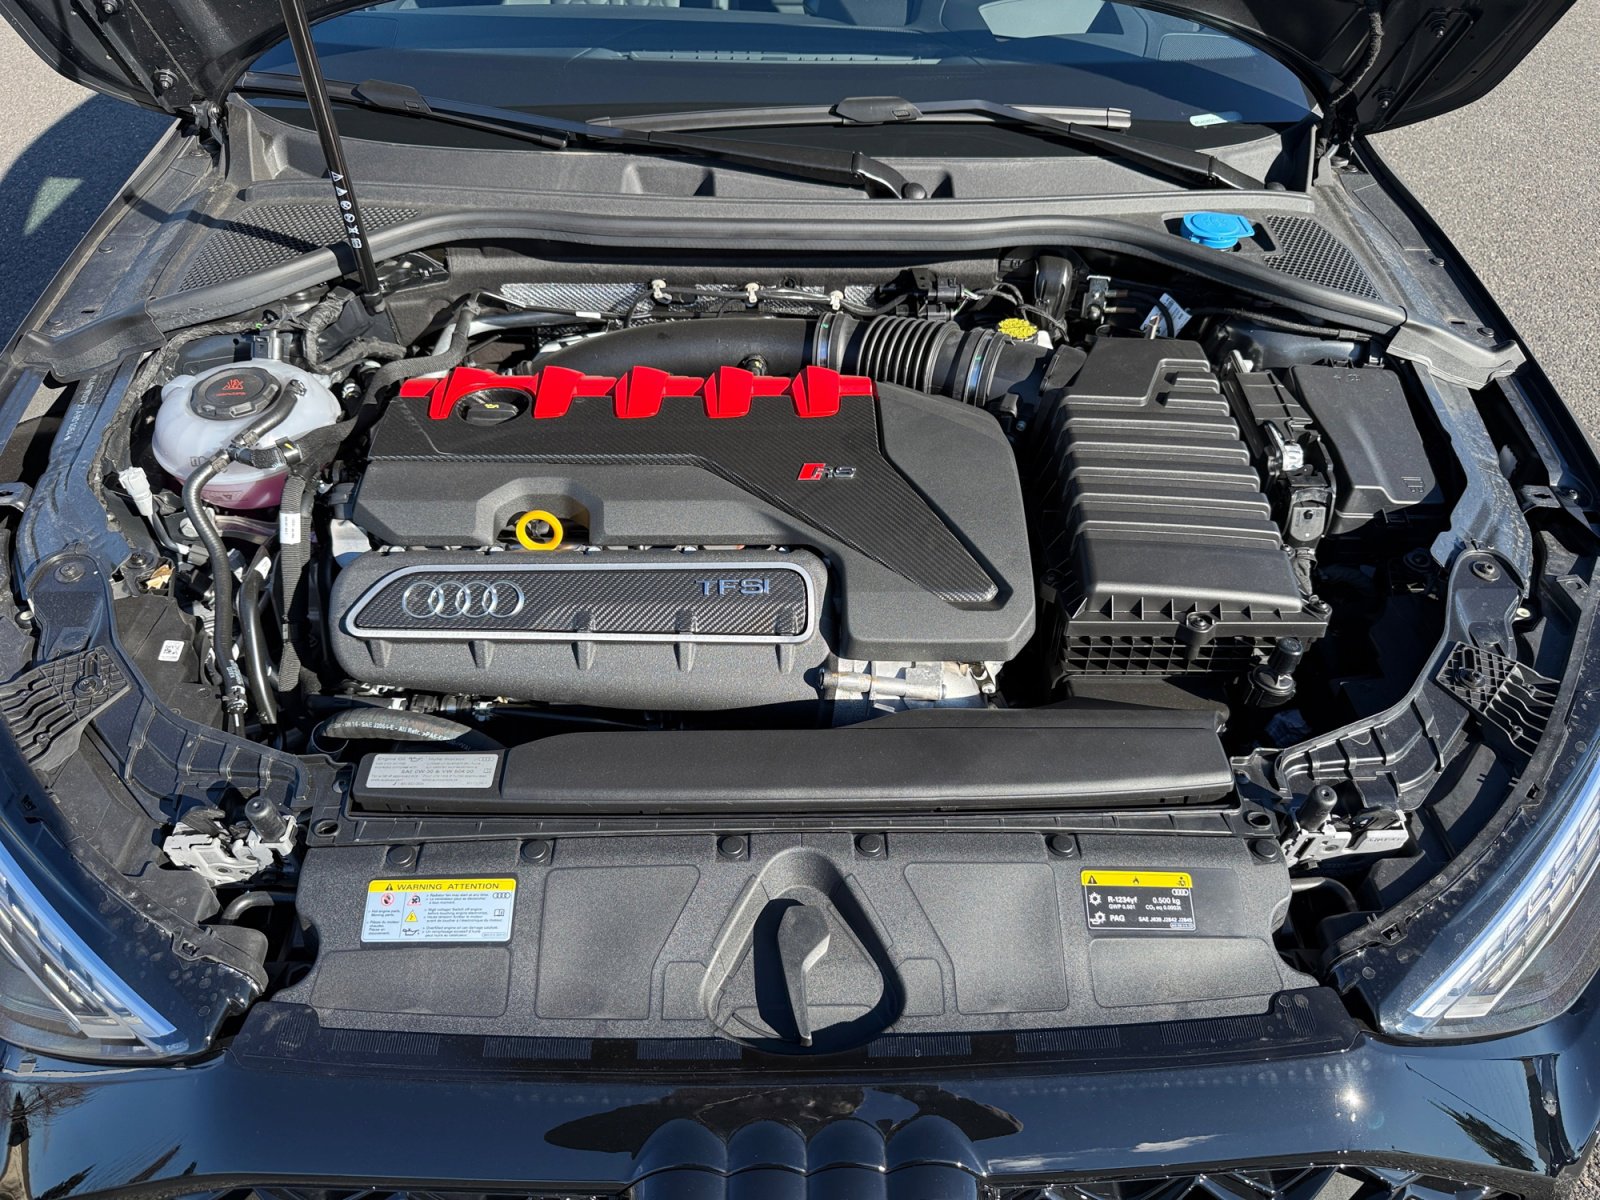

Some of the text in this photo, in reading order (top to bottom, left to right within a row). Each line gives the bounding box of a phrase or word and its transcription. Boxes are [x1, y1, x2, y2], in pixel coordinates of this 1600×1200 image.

[695, 578, 770, 596] TFSI
[1107, 896, 1137, 904] R-1234yf
[1172, 897, 1181, 905] kg
